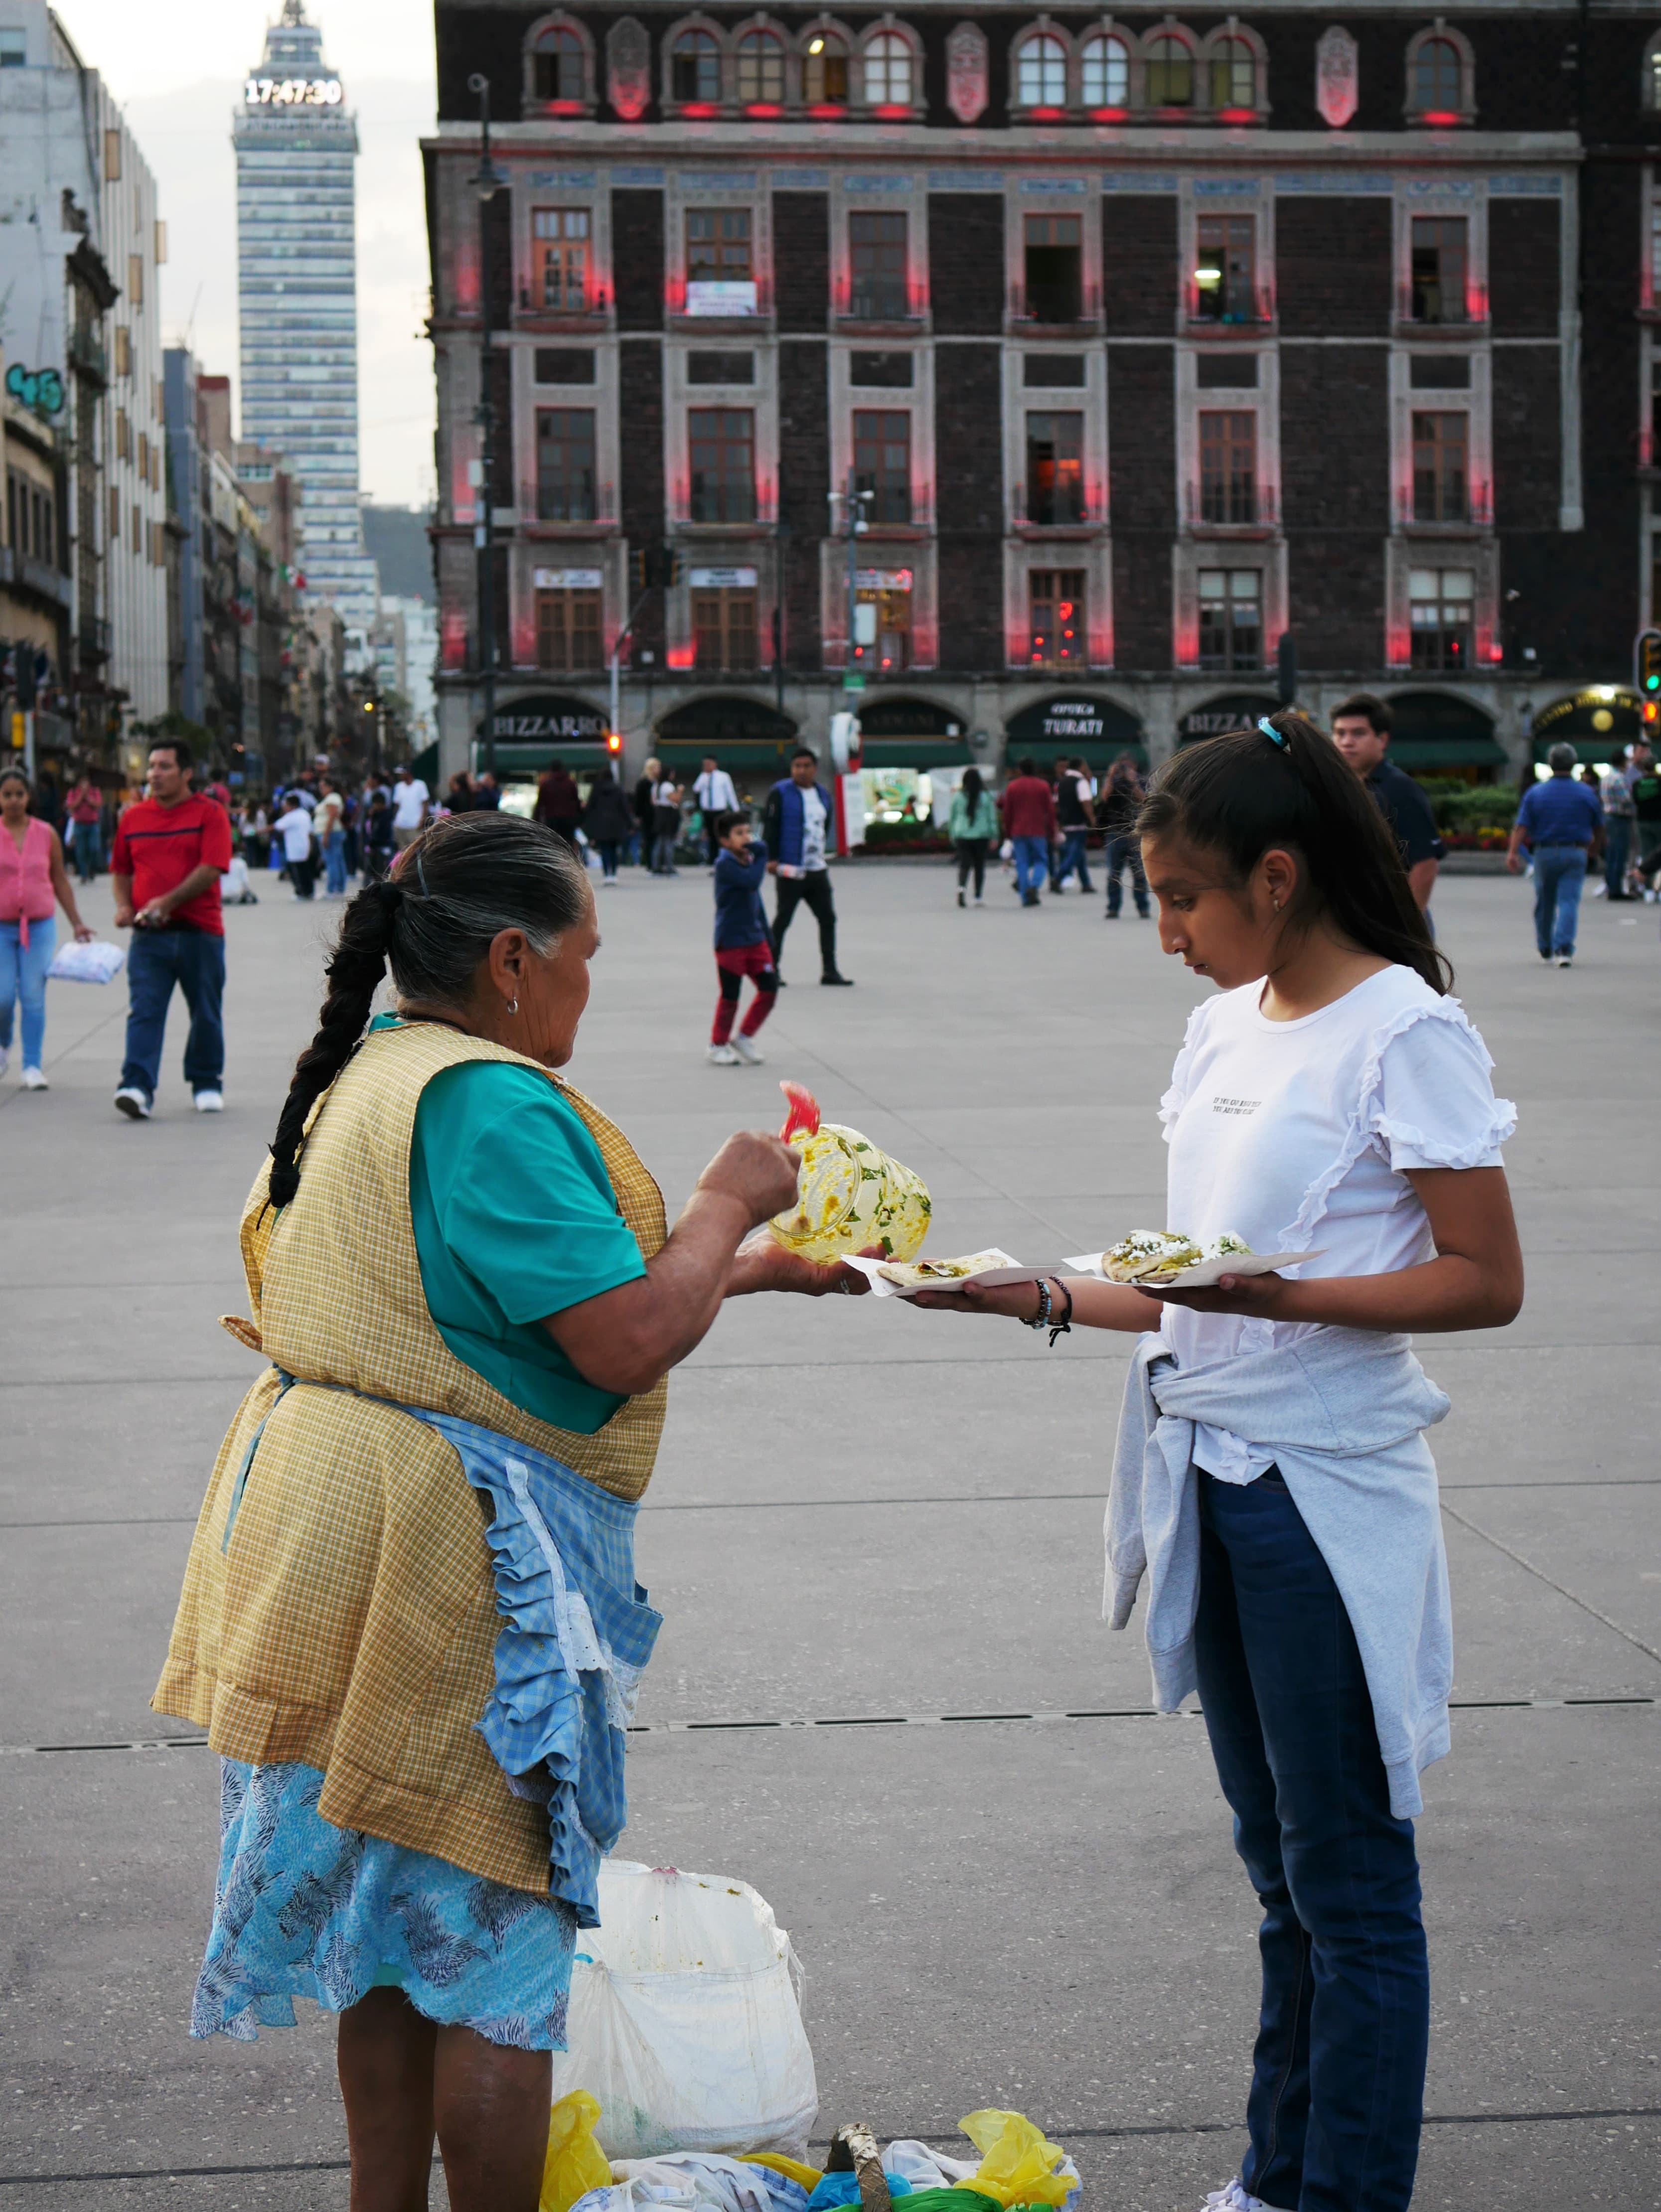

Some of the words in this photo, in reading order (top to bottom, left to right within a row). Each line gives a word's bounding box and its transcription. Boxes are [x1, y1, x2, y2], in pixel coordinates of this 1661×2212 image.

[245, 79, 342, 104] 17:47:30
[493, 716, 607, 736] BIZZARRO
[1043, 719, 1104, 735] TURATI
